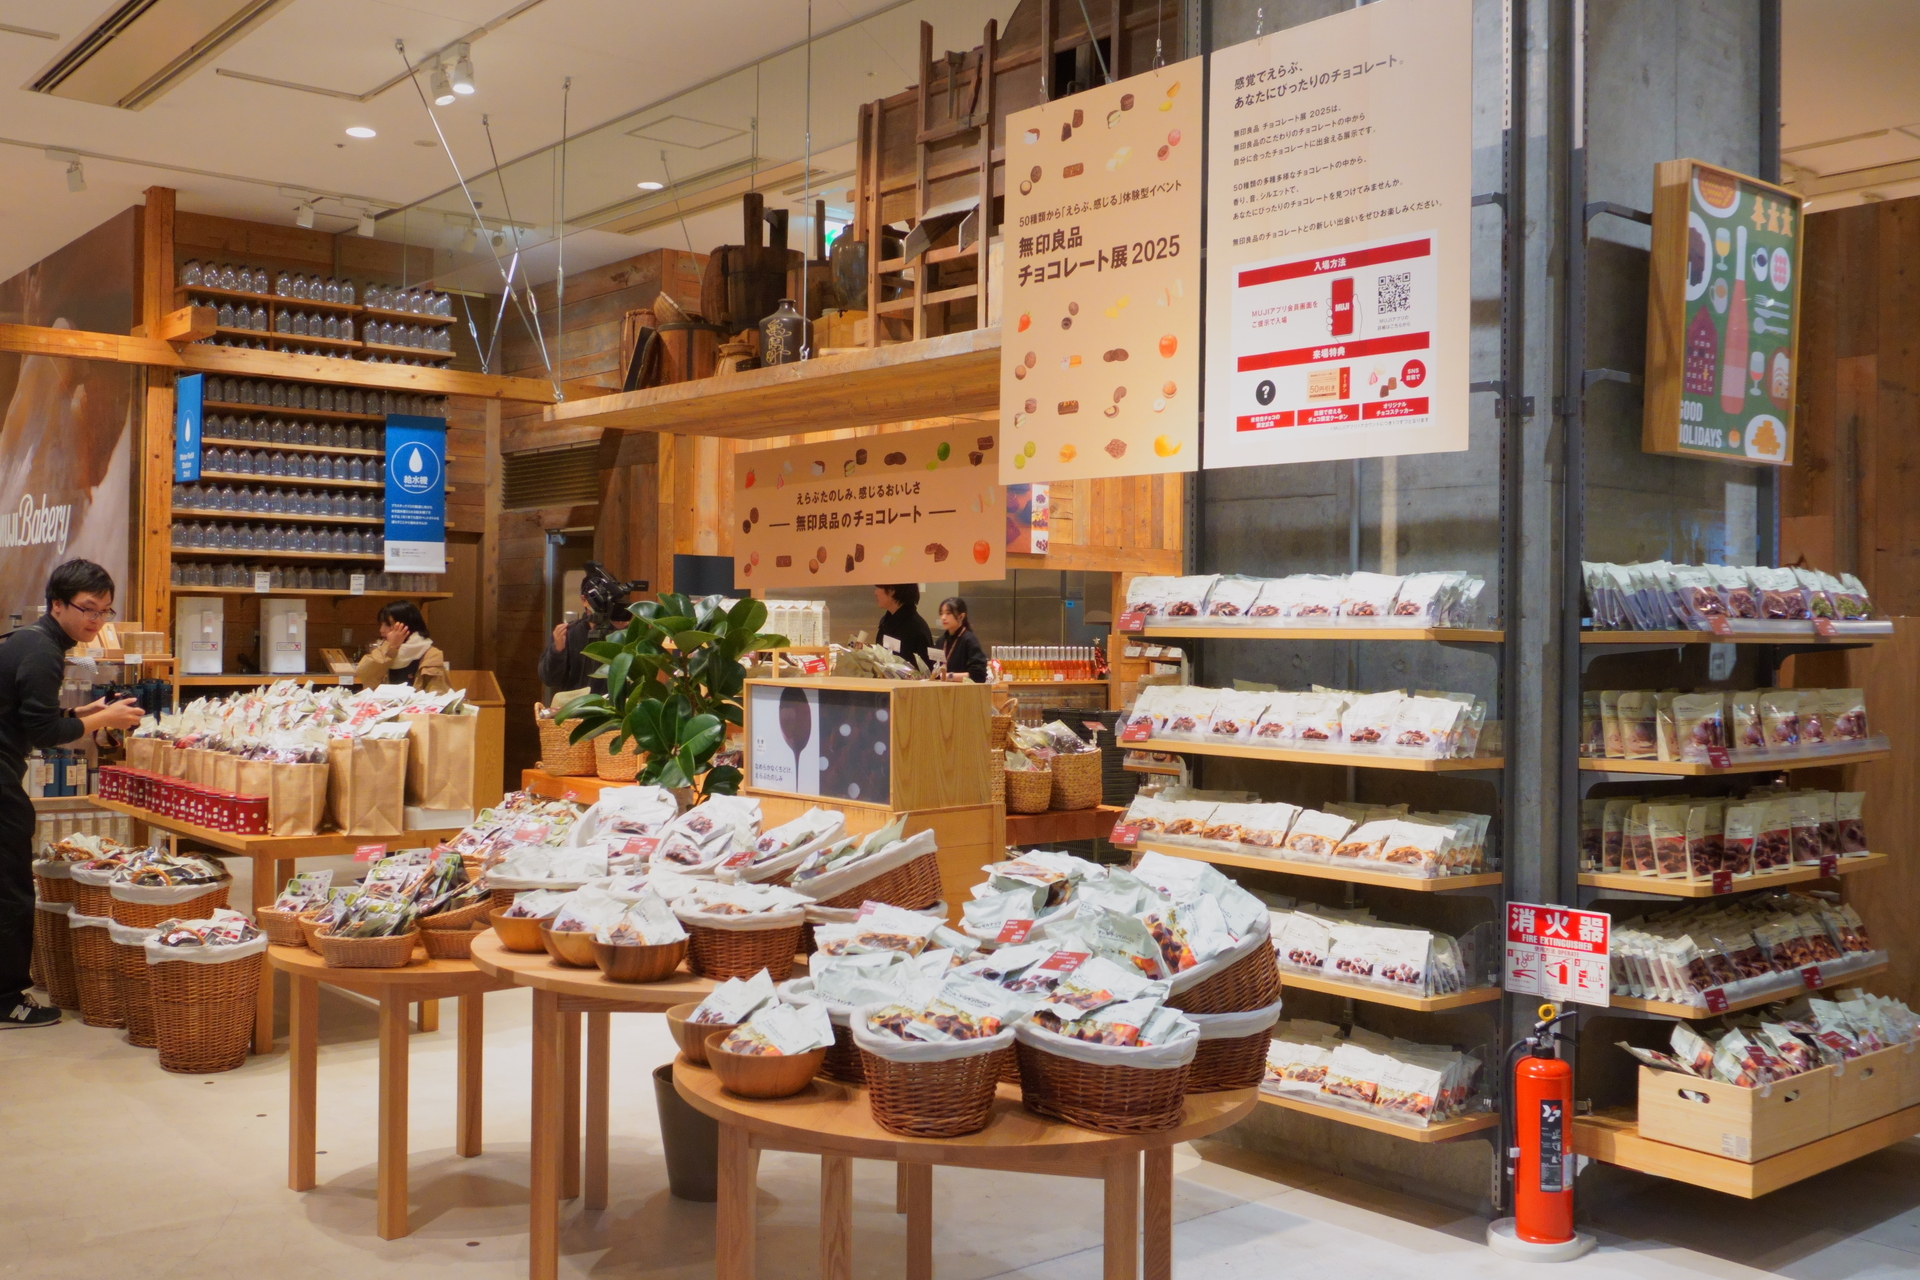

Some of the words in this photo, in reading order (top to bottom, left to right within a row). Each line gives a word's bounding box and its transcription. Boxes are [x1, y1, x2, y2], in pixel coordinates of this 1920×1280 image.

[1234, 62, 1303, 90] 感覚でえらぶ、
[1234, 54, 1404, 109] あなたにぴったりのチョコレート。
[1234, 124, 1260, 138] 無印良品
[1262, 112, 1307, 130] チョコレート展
[1234, 113, 1365, 152] 無印良品のこだわりのチョコレートの中から
[1018, 179, 1182, 228] 50種類から「えらぶ、感じる」体験型イベント
[1233, 179, 1403, 221] あなたにぴったりのチョコレートを見つけてみませんか。
[1018, 226, 1083, 259] 無印良品
[1313, 257, 1346, 272] 入場方法
[1335, 303, 1350, 312] MUJI
[796, 481, 921, 506] えらぶたのしみ、感じるおいしさ
[18, 493, 71, 555] Bakery
[796, 505, 922, 532] 無印良品のチョコレート
[1511, 907, 1604, 943] 消火器
[1522, 934, 1538, 944] FIRE
[1540, 936, 1593, 952] EXTINGUISHER
